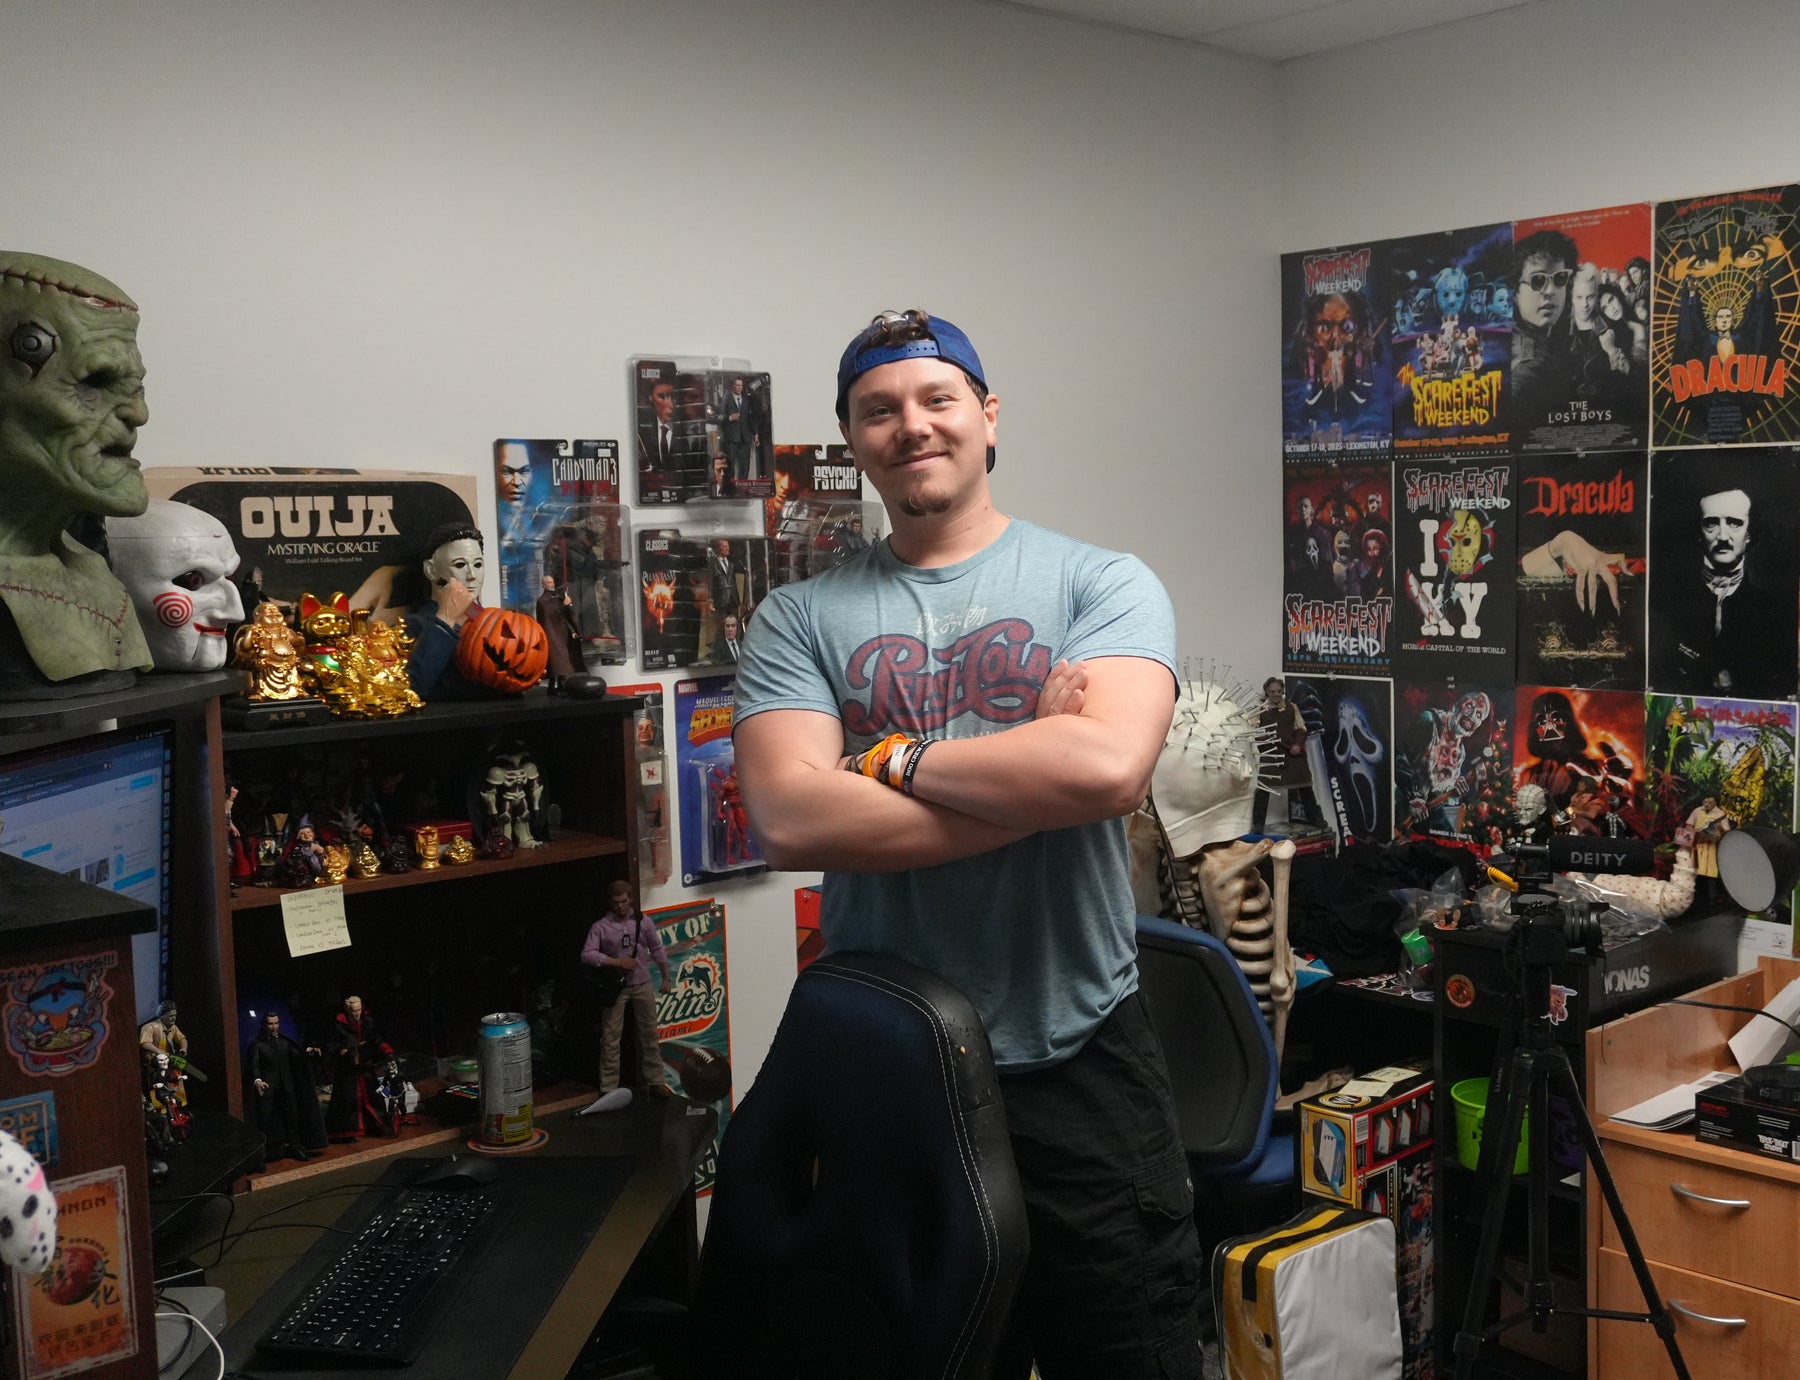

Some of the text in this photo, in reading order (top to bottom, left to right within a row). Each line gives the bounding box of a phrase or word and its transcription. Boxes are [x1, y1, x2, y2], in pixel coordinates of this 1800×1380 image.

[1315, 278, 1362, 295] WEEKEND
[1669, 354, 1785, 403] DRACULA
[1411, 370, 1502, 426] SCAREFEST
[1569, 400, 1588, 411] THE
[1425, 405, 1489, 427] WEEKEND
[1548, 410, 1612, 423] LOST BOYS
[1285, 444, 1310, 453] OCTOBER
[1346, 440, 1380, 450] LEXINGTON,
[1380, 440, 1390, 448] KY
[552, 458, 617, 486] CANDYMAN 3
[813, 465, 858, 490] PSYCHO
[1404, 467, 1510, 513] SCAREFEST
[1523, 469, 1634, 518] Dracula
[1450, 497, 1511, 509] WEEKEND
[240, 495, 400, 538] OUIJA
[267, 541, 379, 555] MYSTIFYING ORACLE
[1419, 519, 1439, 577] I
[1285, 593, 1393, 654] SCAREFEST
[1420, 582, 1488, 640] KY
[1306, 630, 1381, 658] WEEKEND
[1456, 645, 1464, 653] OF
[1482, 647, 1506, 655] WORLD
[678, 683, 698, 694] MARVEL
[695, 698, 718, 709] MARVEL
[1570, 851, 1627, 866] DEITY
[684, 912, 711, 939] OF
